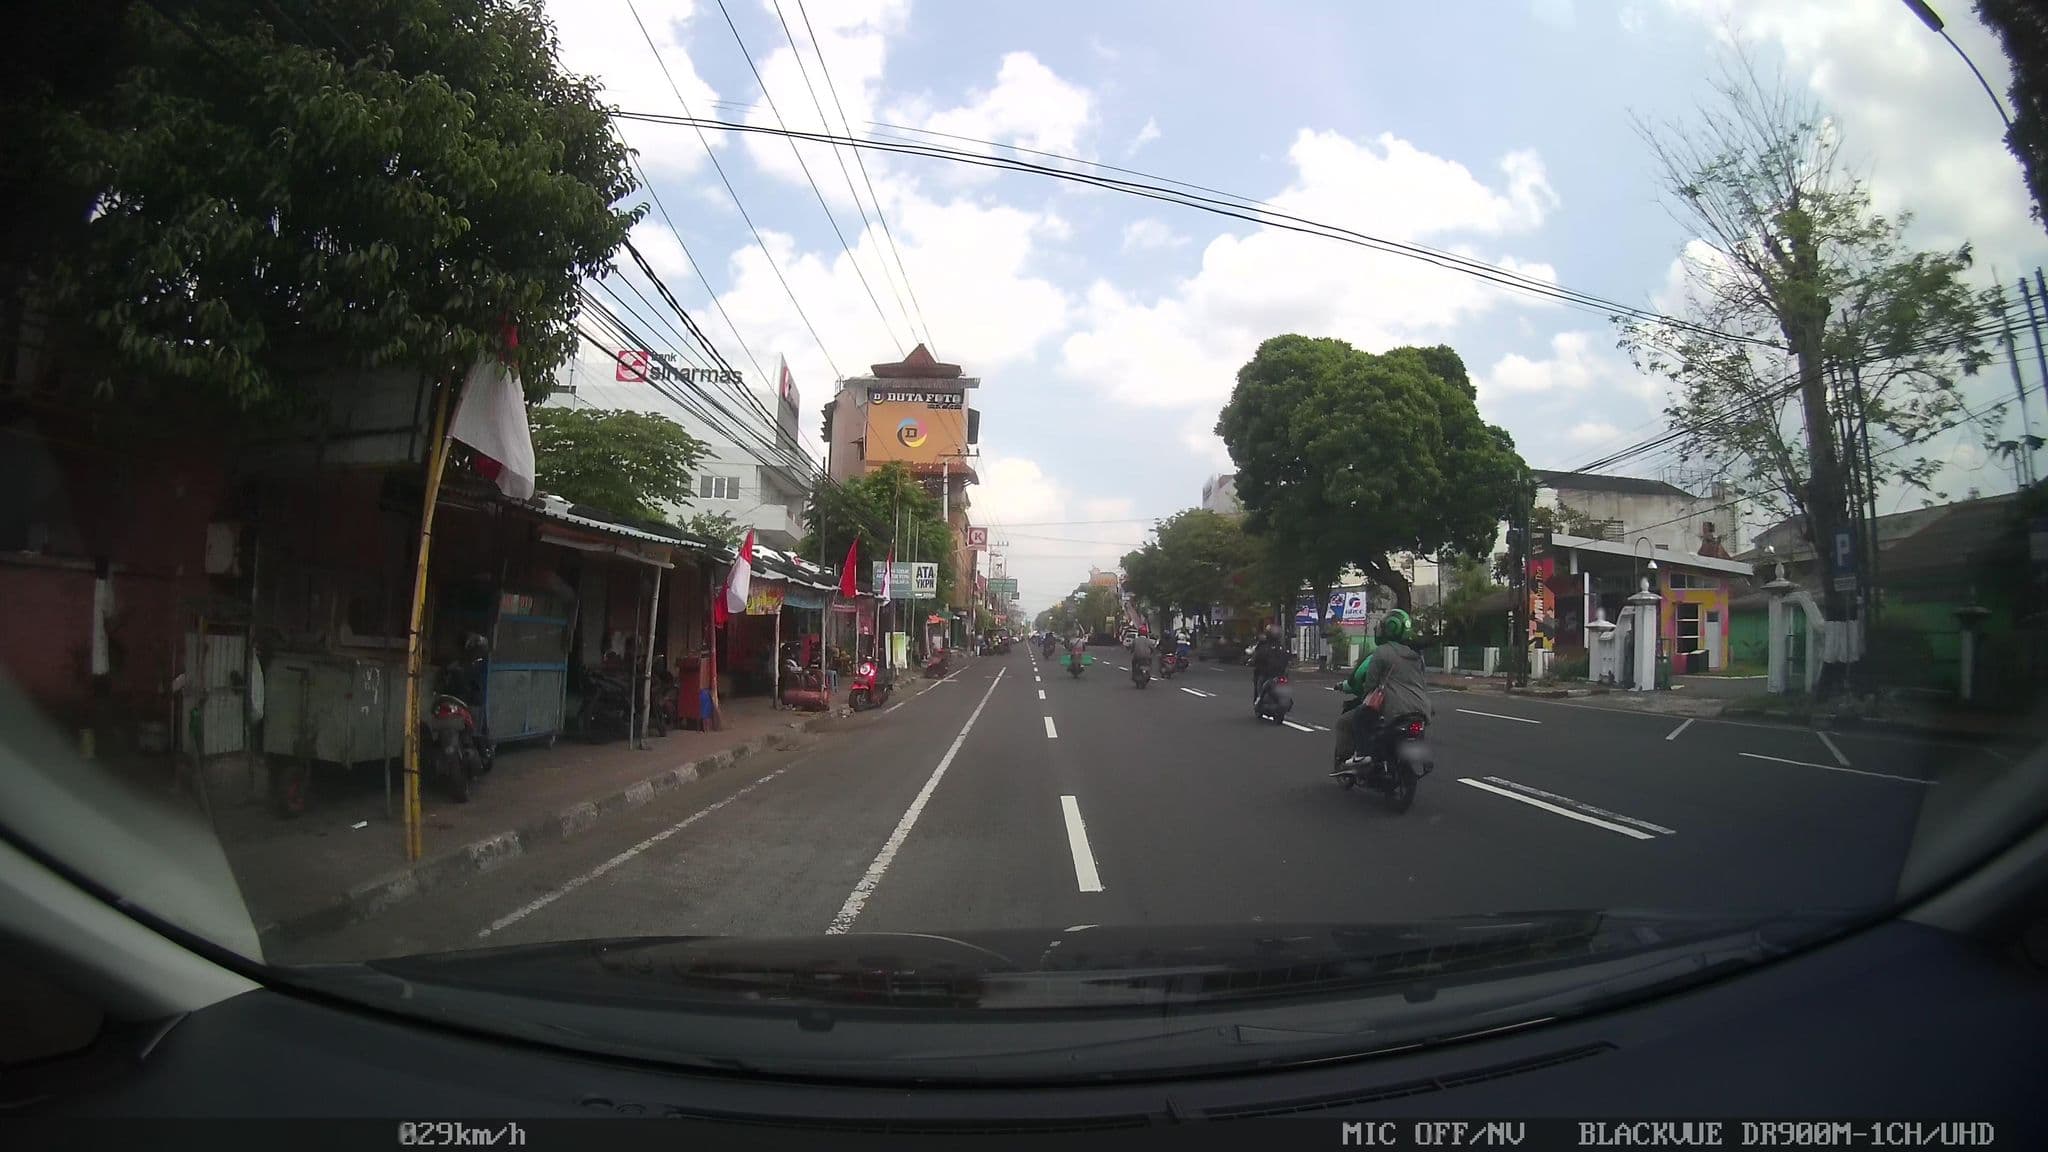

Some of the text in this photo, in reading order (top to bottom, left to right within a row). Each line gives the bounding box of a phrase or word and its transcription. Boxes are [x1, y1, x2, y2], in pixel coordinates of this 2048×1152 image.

[650, 366, 743, 383] sinarmas
[887, 392, 923, 401] DUTA
[926, 393, 961, 402] FOTO
[1836, 533, 1850, 567] P
[916, 566, 934, 578] ATA
[1534, 600, 1545, 622] ATM
